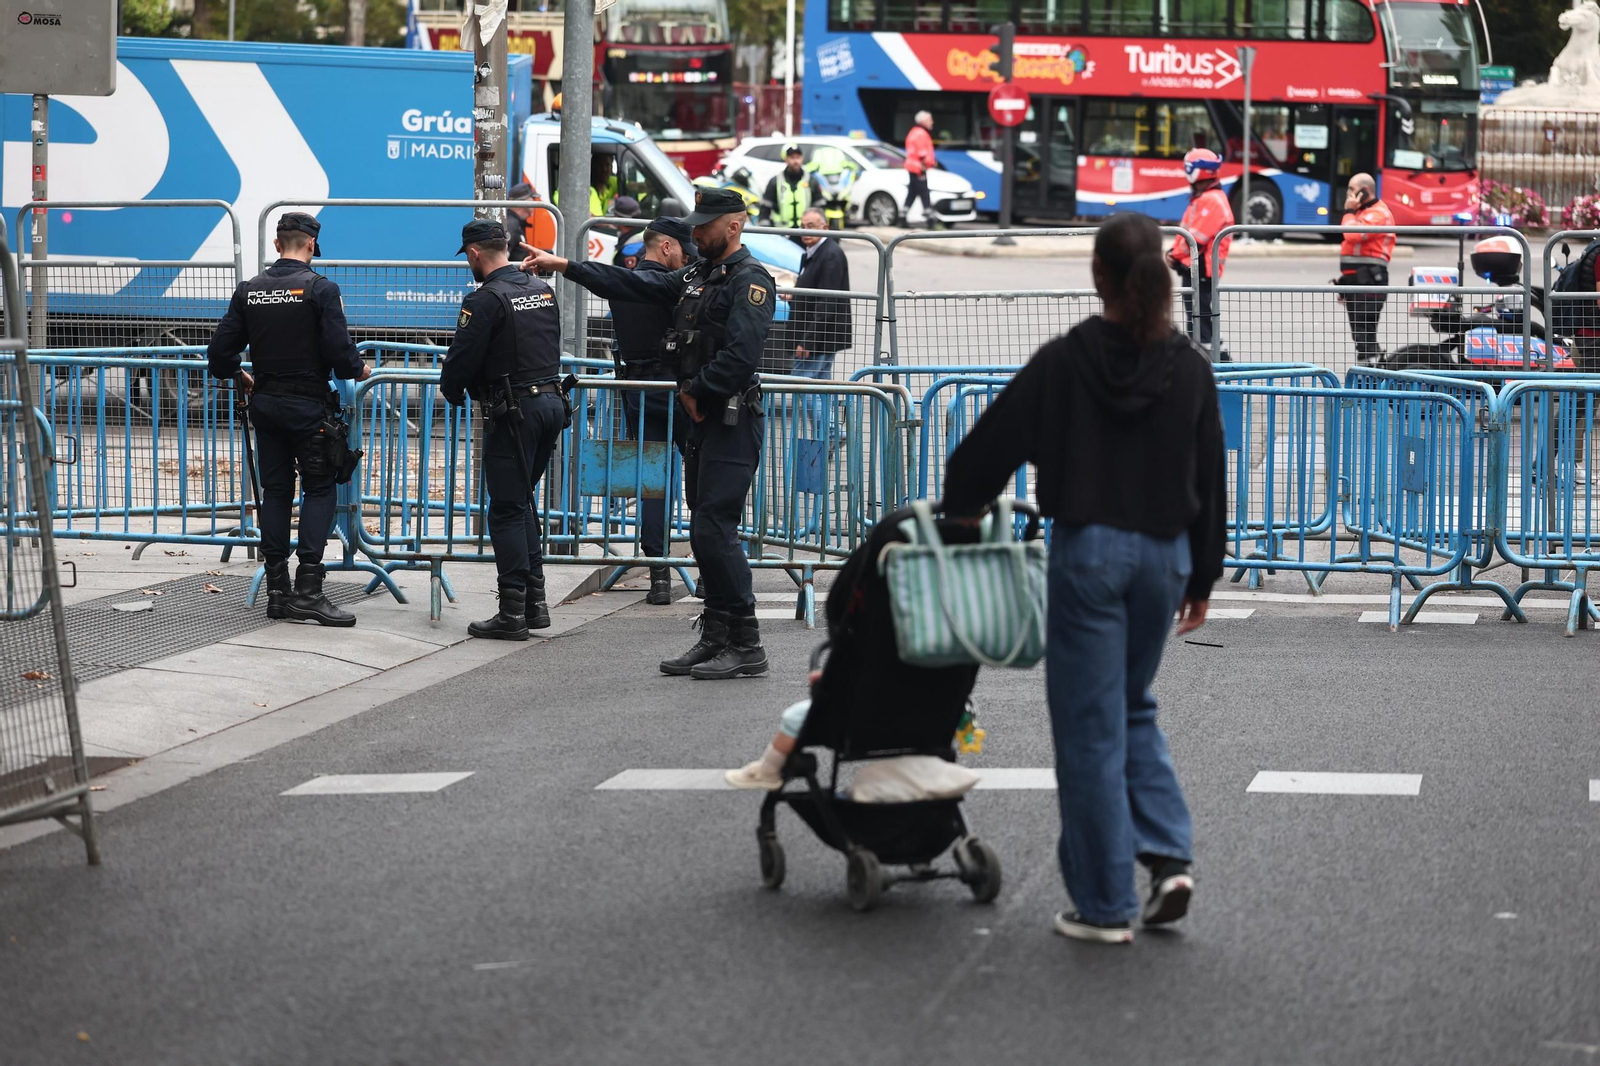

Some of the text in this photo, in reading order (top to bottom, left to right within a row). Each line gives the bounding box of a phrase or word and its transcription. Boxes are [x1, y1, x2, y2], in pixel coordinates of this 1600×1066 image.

[33, 18, 62, 26] MOSA
[1123, 43, 1214, 75] Turibus
[411, 142, 474, 160] MADRI
[247, 289, 292, 298] POLICIA
[386, 289, 463, 304] emtmadrid
[510, 293, 546, 306] POLICIA
[247, 296, 304, 306] NACIONAL
[512, 299, 554, 312] NACIONAL
